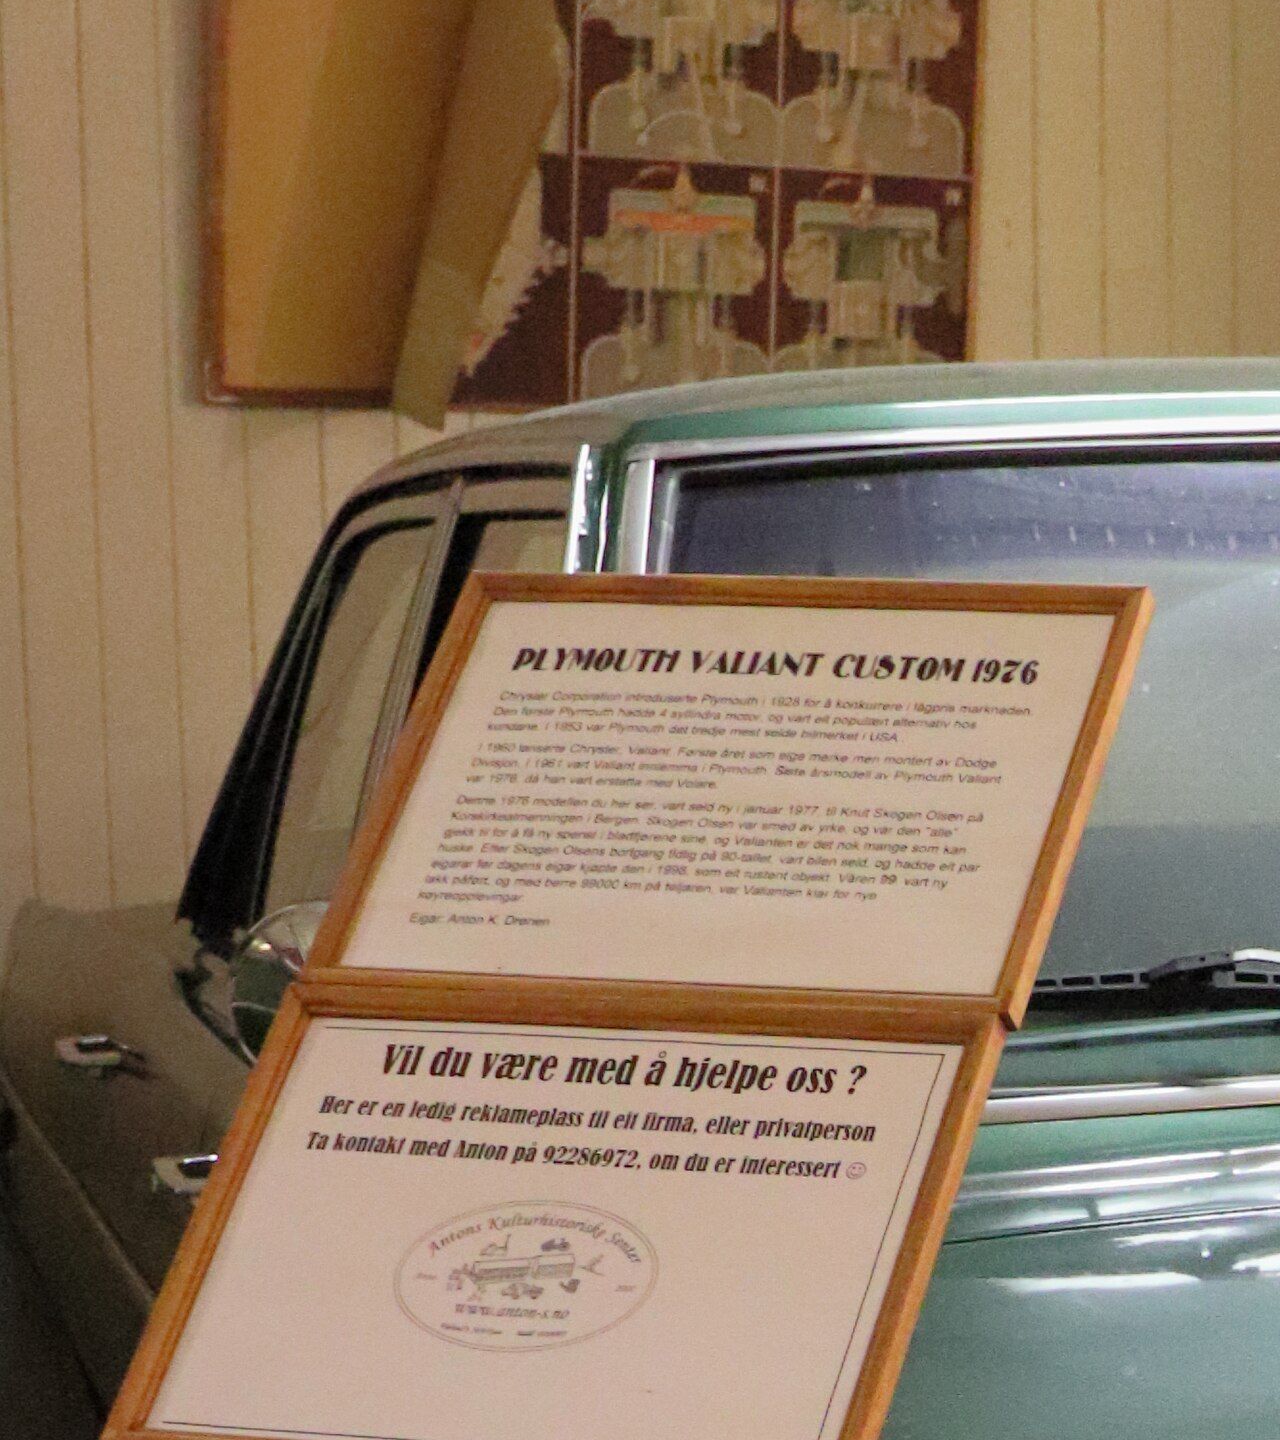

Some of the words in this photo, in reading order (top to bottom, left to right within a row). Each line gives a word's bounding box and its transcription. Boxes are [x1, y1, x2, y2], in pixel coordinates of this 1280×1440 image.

[512, 647, 681, 674] PLYMOUTH
[692, 650, 825, 677] VALIANT
[832, 654, 966, 683] CUSTOM
[971, 658, 1038, 686] 1976
[498, 689, 548, 700] Chrysler
[551, 690, 622, 702] Corporation
[699, 695, 759, 707] Plymouth
[556, 707, 615, 718] Plymouth
[606, 724, 665, 735] Plymouth
[592, 760, 635, 770] Valiant
[893, 770, 954, 783] Plymouth
[957, 772, 1002, 782] Valiant
[644, 816, 694, 828] Skogen
[696, 818, 734, 828] Olsen
[871, 809, 922, 821] Skogen
[925, 810, 964, 820] Olsen
[733, 836, 794, 847] Valianten
[511, 843, 560, 856] Skogen
[741, 885, 803, 896] Valianten
[382, 1043, 425, 1077] Vil
[428, 1046, 472, 1079] du
[480, 1051, 559, 1082] være
[564, 1054, 640, 1086] med
[643, 1050, 668, 1087] å
[672, 1056, 778, 1095] hjelpe
[785, 1065, 838, 1095] oss
[847, 1064, 868, 1095] ?
[318, 1094, 355, 1115] Her
[356, 1101, 380, 1117] er
[381, 1101, 407, 1118] en
[407, 1099, 457, 1123] ledig
[459, 1103, 584, 1129] reklameplass
[587, 1110, 611, 1130] til
[612, 1111, 640, 1131] eit
[640, 1111, 698, 1135] firma,
[704, 1114, 751, 1137] eller
[752, 1116, 877, 1143] privatperson
[305, 1130, 329, 1151] Ta
[332, 1133, 405, 1156] kontakt
[407, 1138, 451, 1158] med
[453, 1139, 509, 1162] Anton
[510, 1141, 538, 1165] på
[541, 1145, 642, 1170] 92286972,
[647, 1152, 680, 1172] om
[683, 1152, 708, 1173] du
[713, 1156, 734, 1174] er
[738, 1156, 842, 1179] interessert
[428, 1221, 482, 1257] Antons
